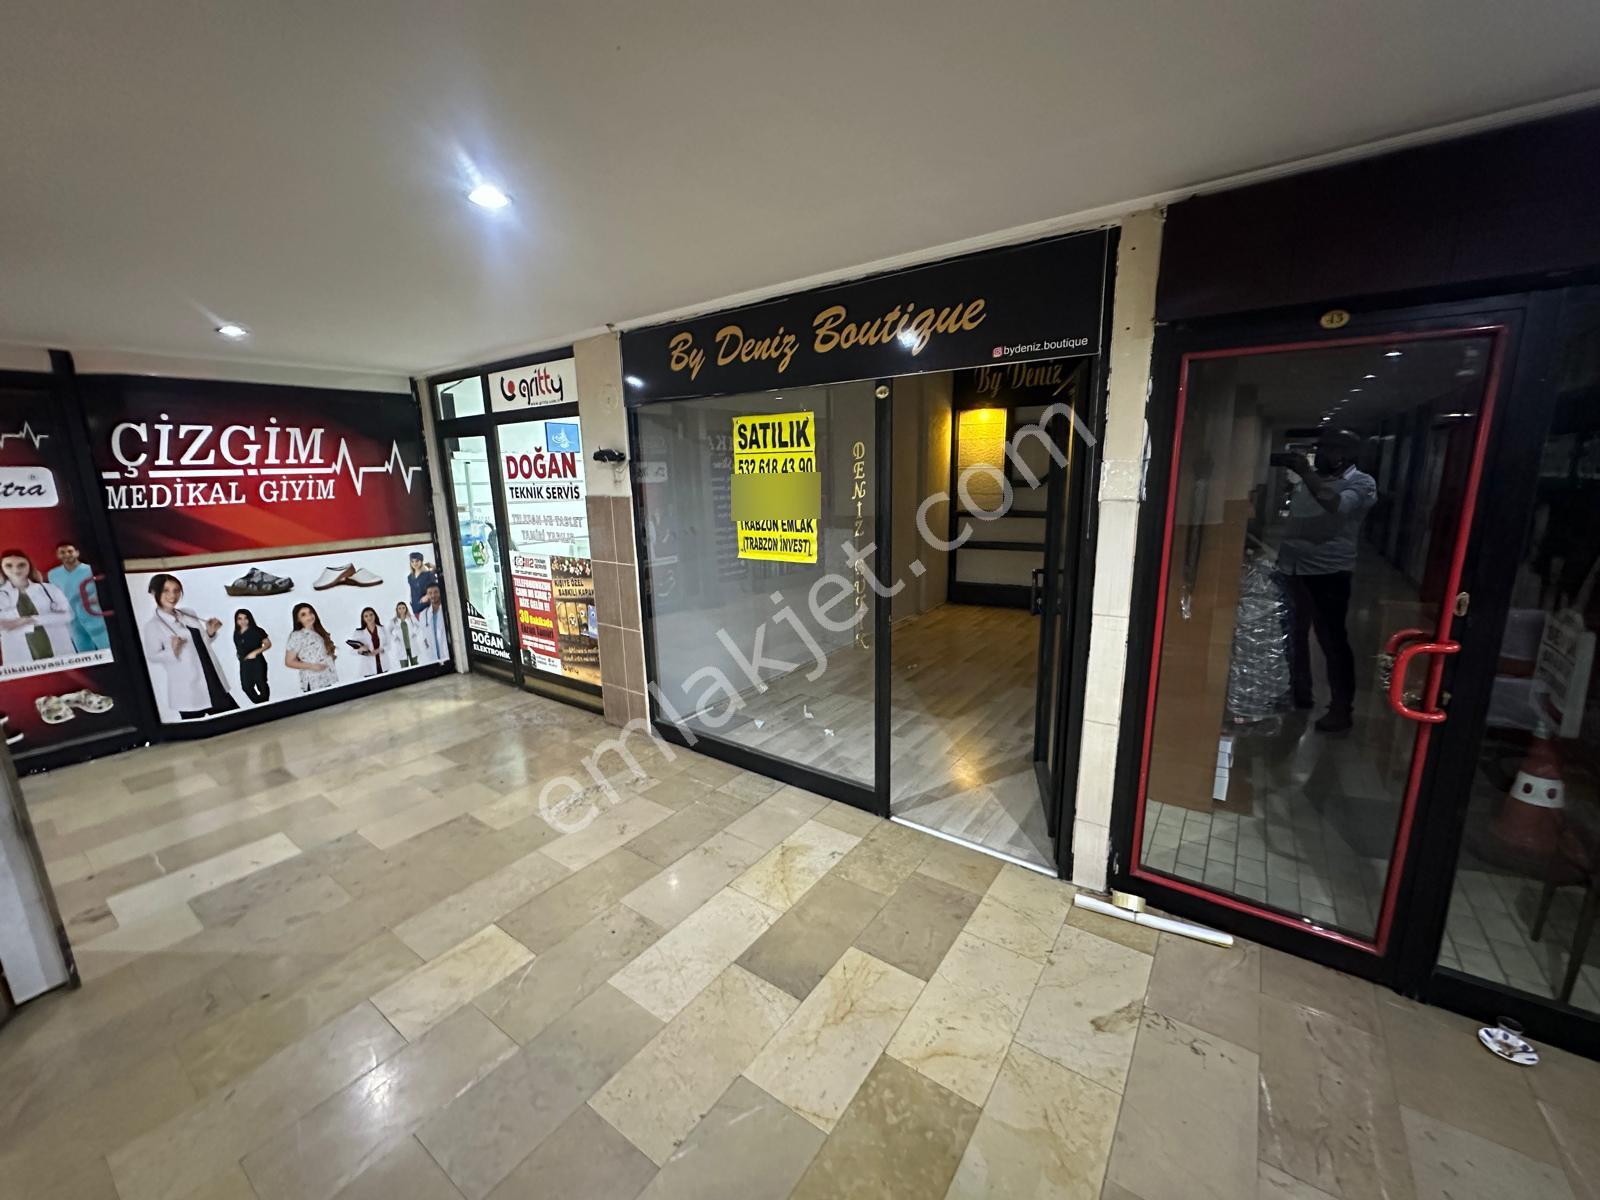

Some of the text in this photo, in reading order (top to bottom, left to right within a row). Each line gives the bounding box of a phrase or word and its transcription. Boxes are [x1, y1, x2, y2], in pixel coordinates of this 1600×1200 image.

[669, 298, 987, 381] By Deniz Boutique
[1003, 337, 1088, 356] bydeniz.boutique
[737, 420, 811, 450] SATILIK
[111, 413, 325, 478] ÇİZGİM
[505, 446, 577, 480] DOĞAN
[0, 482, 46, 497] tra
[105, 475, 335, 510] MEDİKAL GİYİM
[509, 482, 580, 500] TEKNİK SERVİS
[781, 518, 814, 533] EMLAK
[519, 609, 529, 623] 30
[471, 631, 504, 650] DOĞAN
[473, 643, 511, 660] ELEKTRONİK
